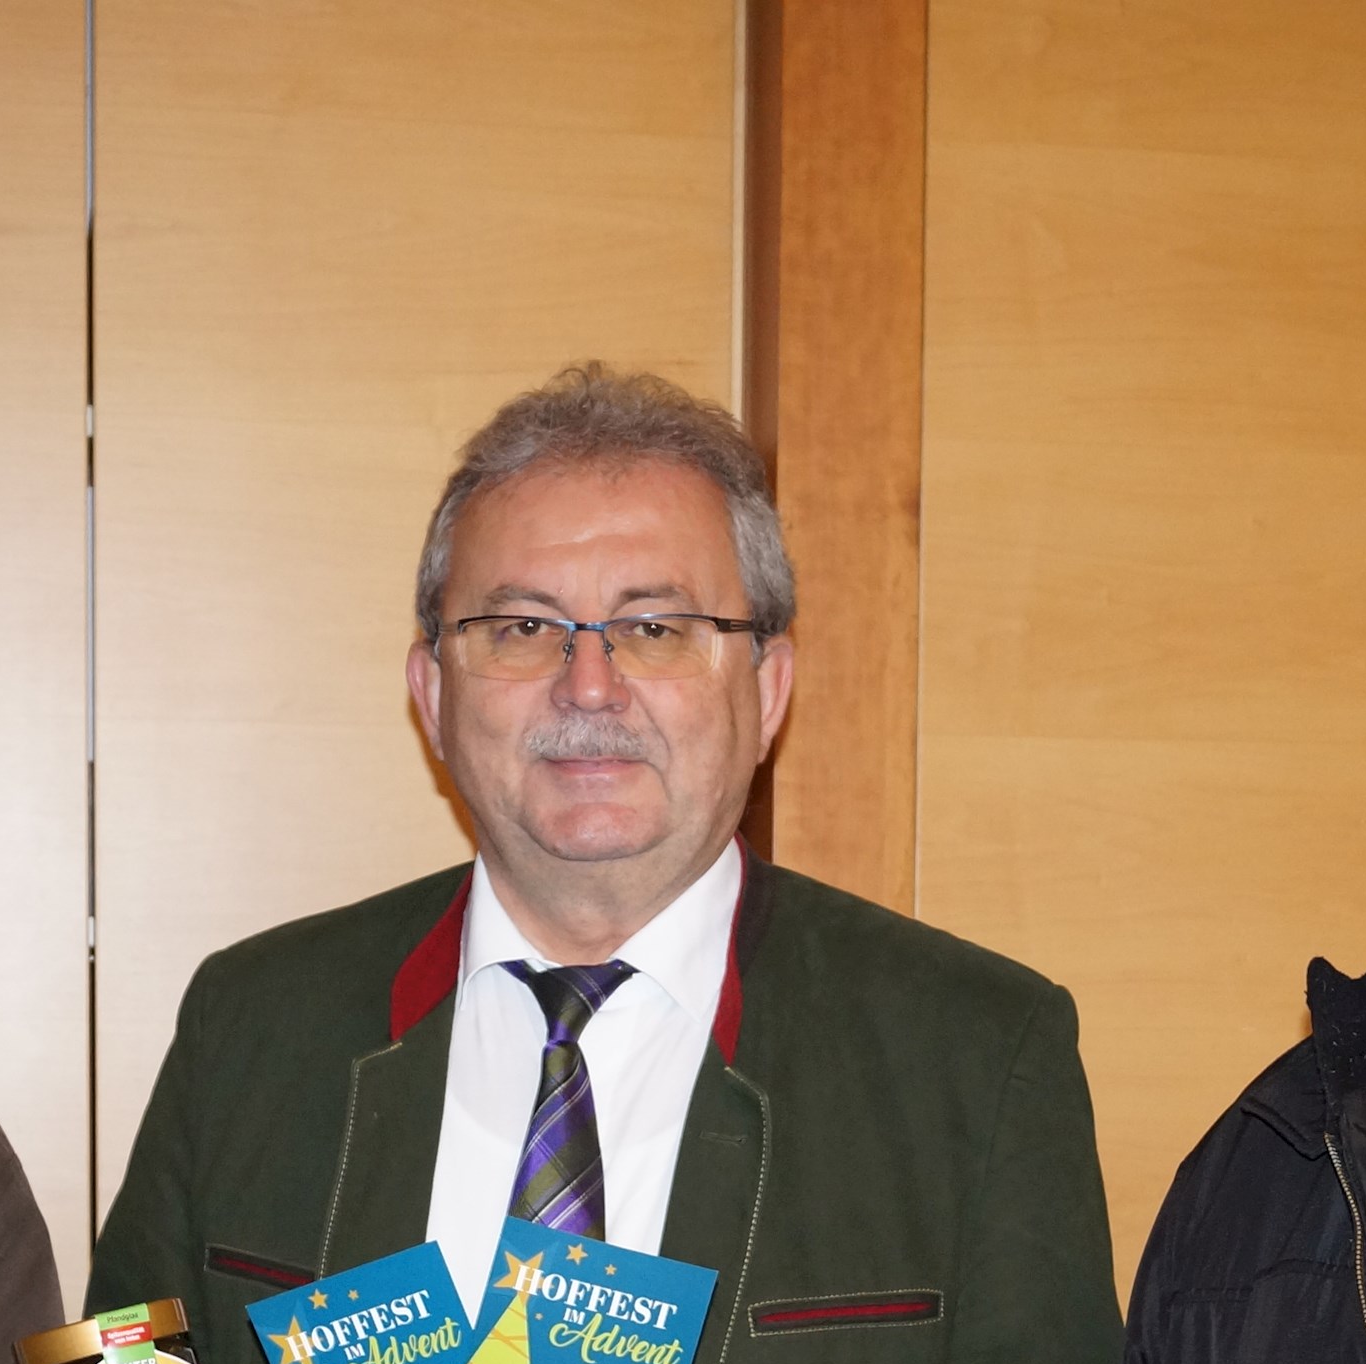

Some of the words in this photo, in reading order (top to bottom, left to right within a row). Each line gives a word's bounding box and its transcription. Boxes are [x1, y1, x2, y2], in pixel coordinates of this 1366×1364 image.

[512, 1264, 678, 1330] HOFFEST
[563, 1307, 585, 1326] IM
[285, 1289, 431, 1362] HOFFEST
[344, 1343, 365, 1360] IM
